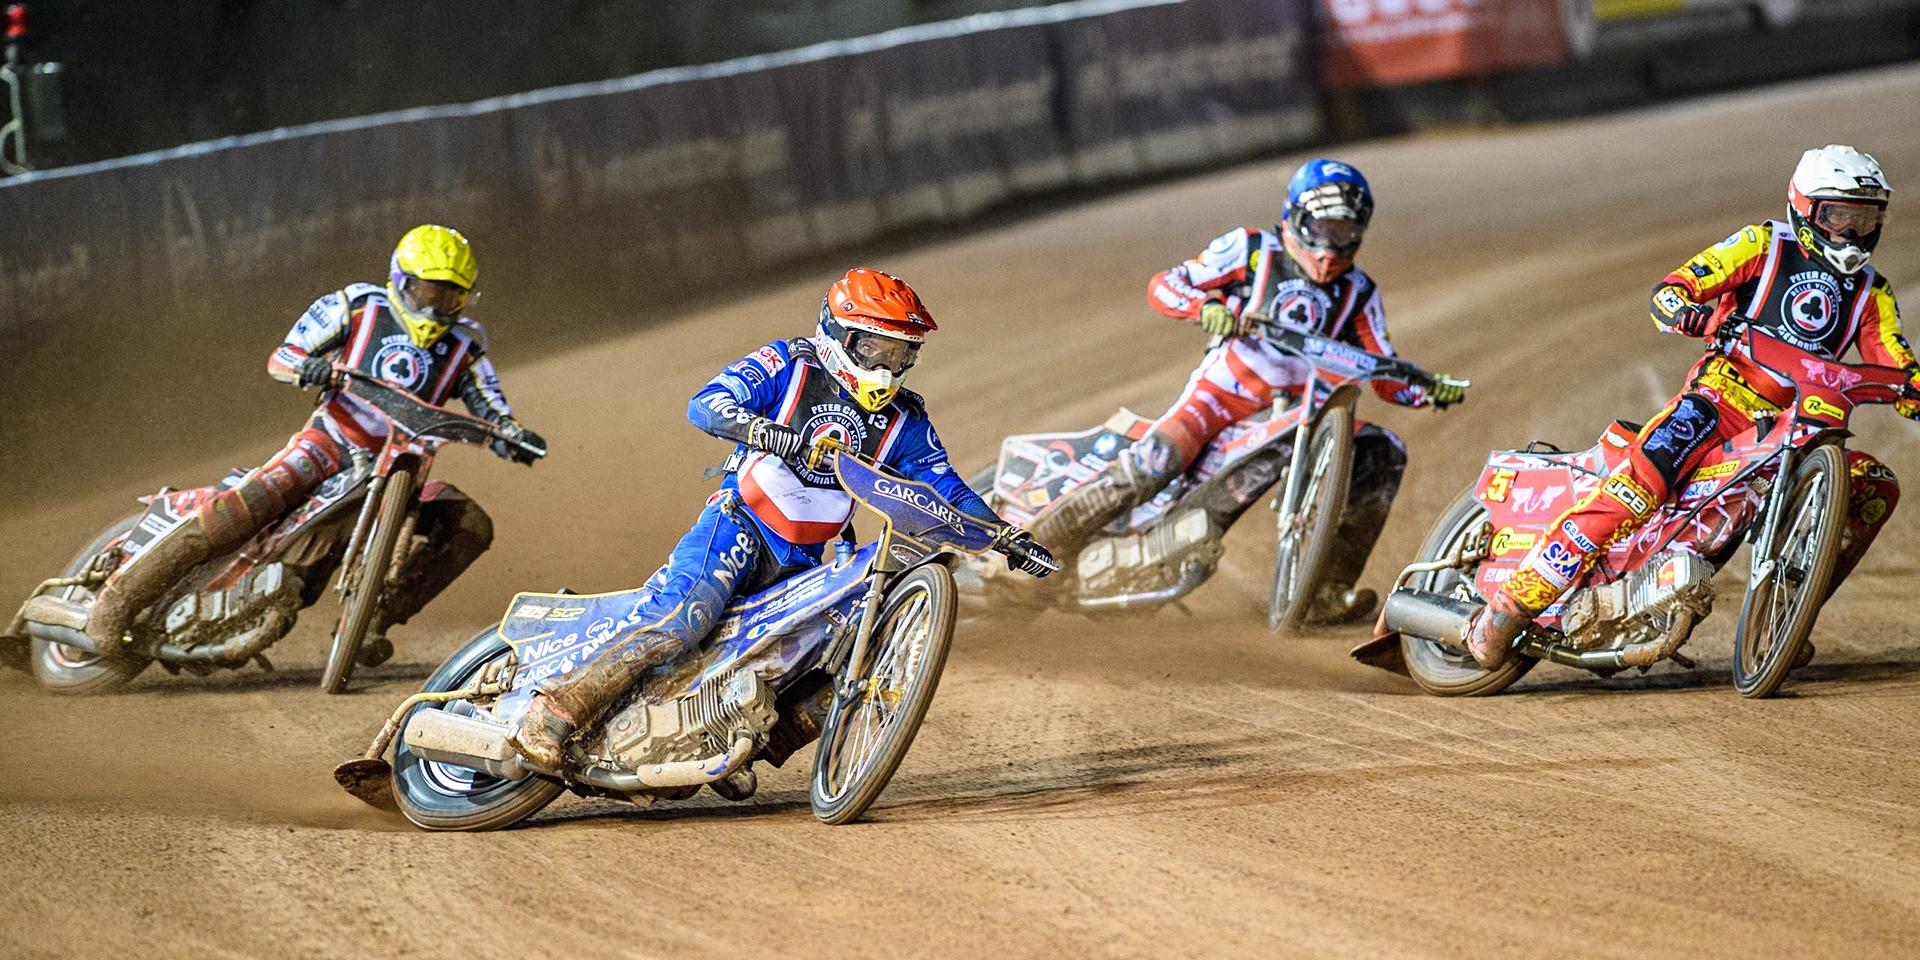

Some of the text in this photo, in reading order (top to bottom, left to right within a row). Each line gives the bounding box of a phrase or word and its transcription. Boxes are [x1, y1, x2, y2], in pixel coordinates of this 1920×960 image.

[1789, 270, 1819, 284] PETER
[1790, 283, 1812, 298] BELLE
[1815, 283, 1830, 294] VUE
[810, 415, 858, 451] BELLE VUE ACES
[811, 403, 868, 439] PETER CRAVEN
[868, 413, 889, 430] 13
[1488, 469, 1516, 501] 5
[1606, 480, 1648, 515] JCB
[873, 478, 966, 535] GARCAREK
[1574, 533, 1597, 553] AUT
[713, 533, 753, 593] Nice
[582, 594, 652, 661] ANLAS
[523, 633, 578, 663] Nice
